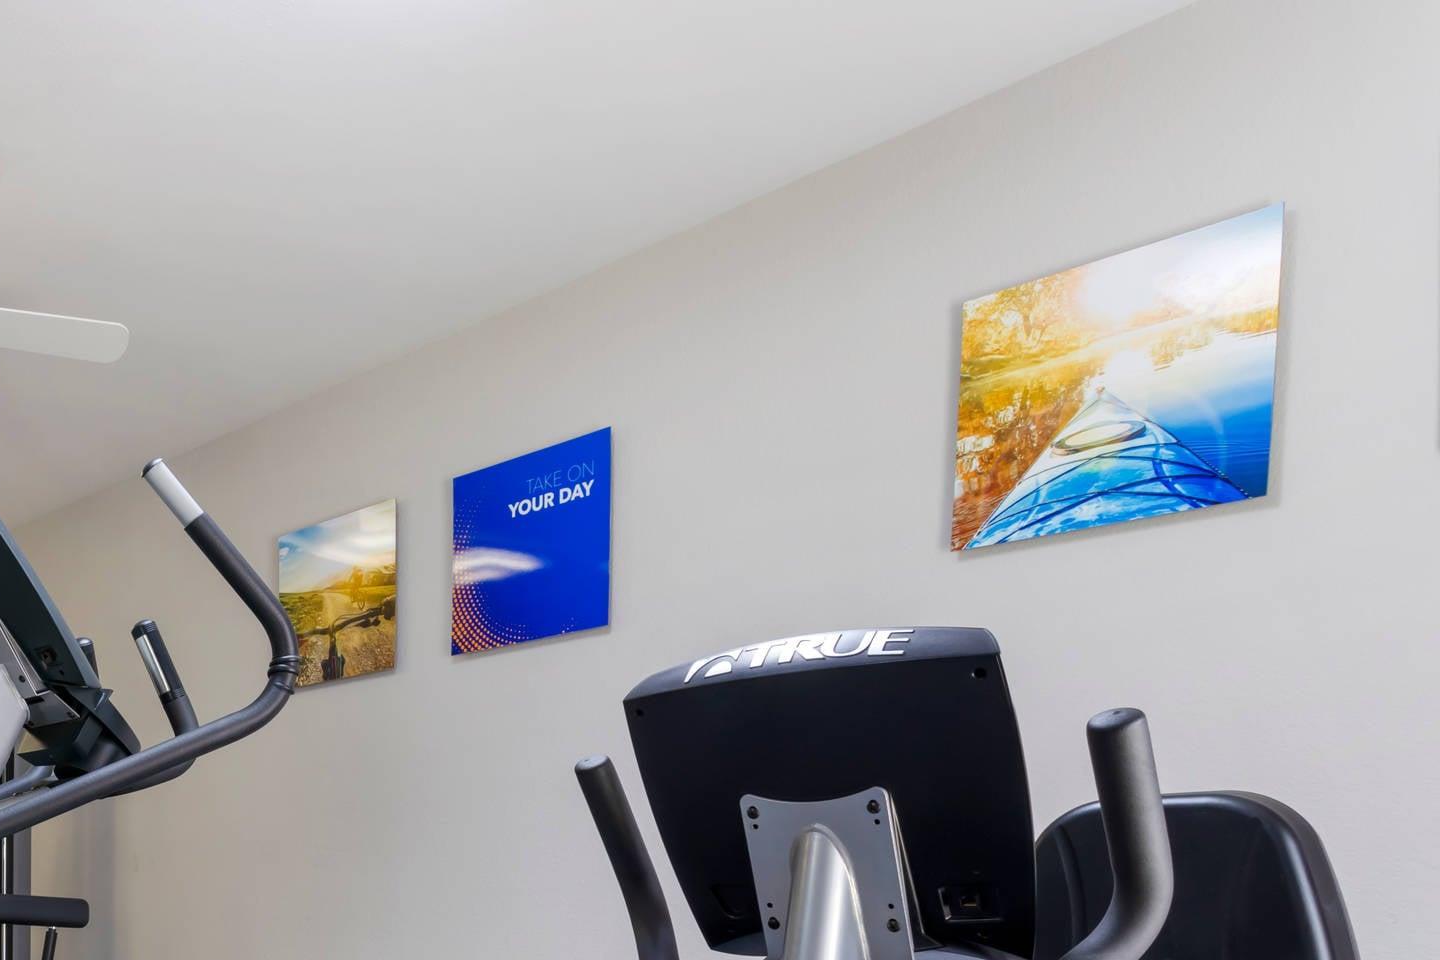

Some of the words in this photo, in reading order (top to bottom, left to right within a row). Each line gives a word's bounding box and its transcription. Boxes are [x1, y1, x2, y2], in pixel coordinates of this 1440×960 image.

[526, 470, 562, 494] TAKE
[567, 460, 595, 482] ON
[508, 491, 555, 518] YOUR
[559, 479, 594, 504] DAY
[744, 629, 915, 669] TRUE
